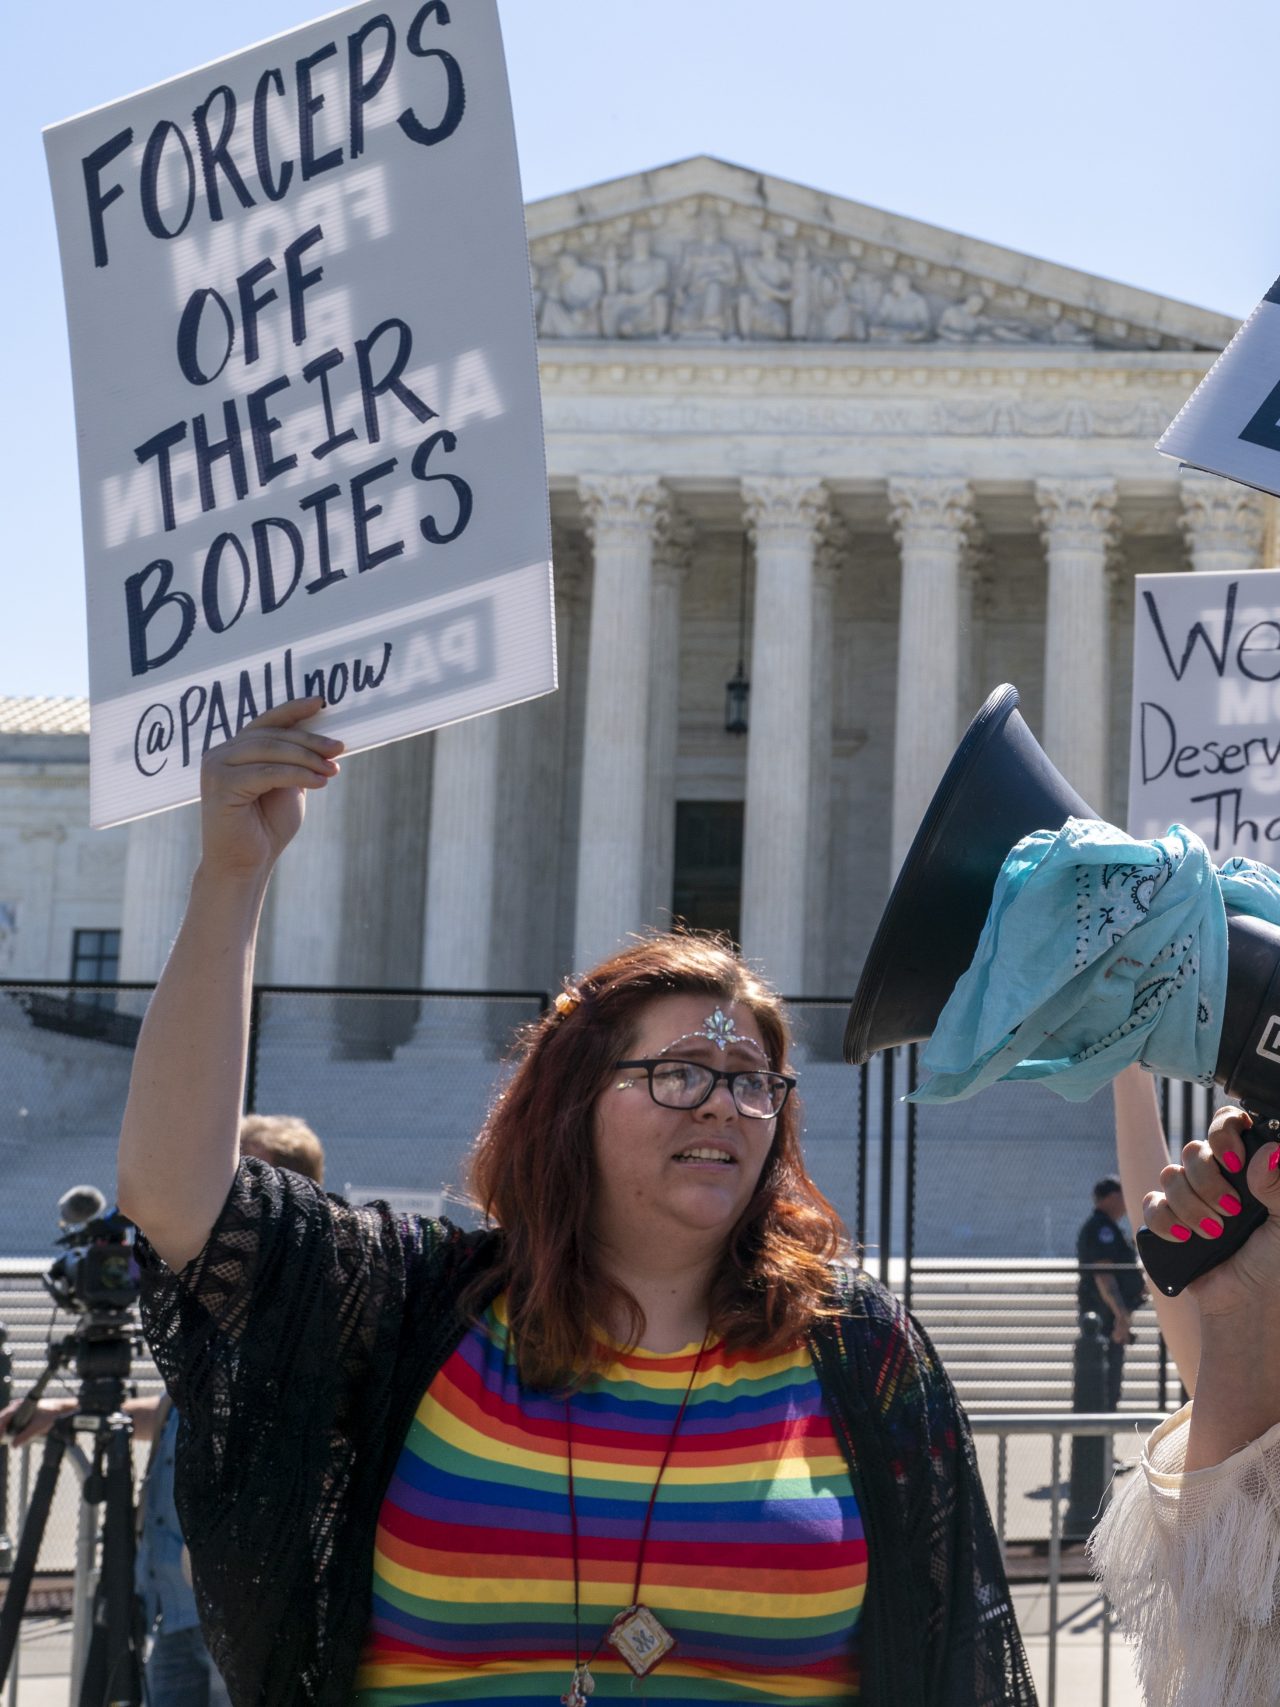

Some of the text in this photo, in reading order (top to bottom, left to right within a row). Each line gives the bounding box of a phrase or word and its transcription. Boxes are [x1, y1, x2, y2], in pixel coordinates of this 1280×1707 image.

[81, 0, 466, 268] FORCEPS
[176, 224, 324, 386] OFF
[134, 317, 440, 532] THEIR
[124, 429, 474, 677] BODIES
